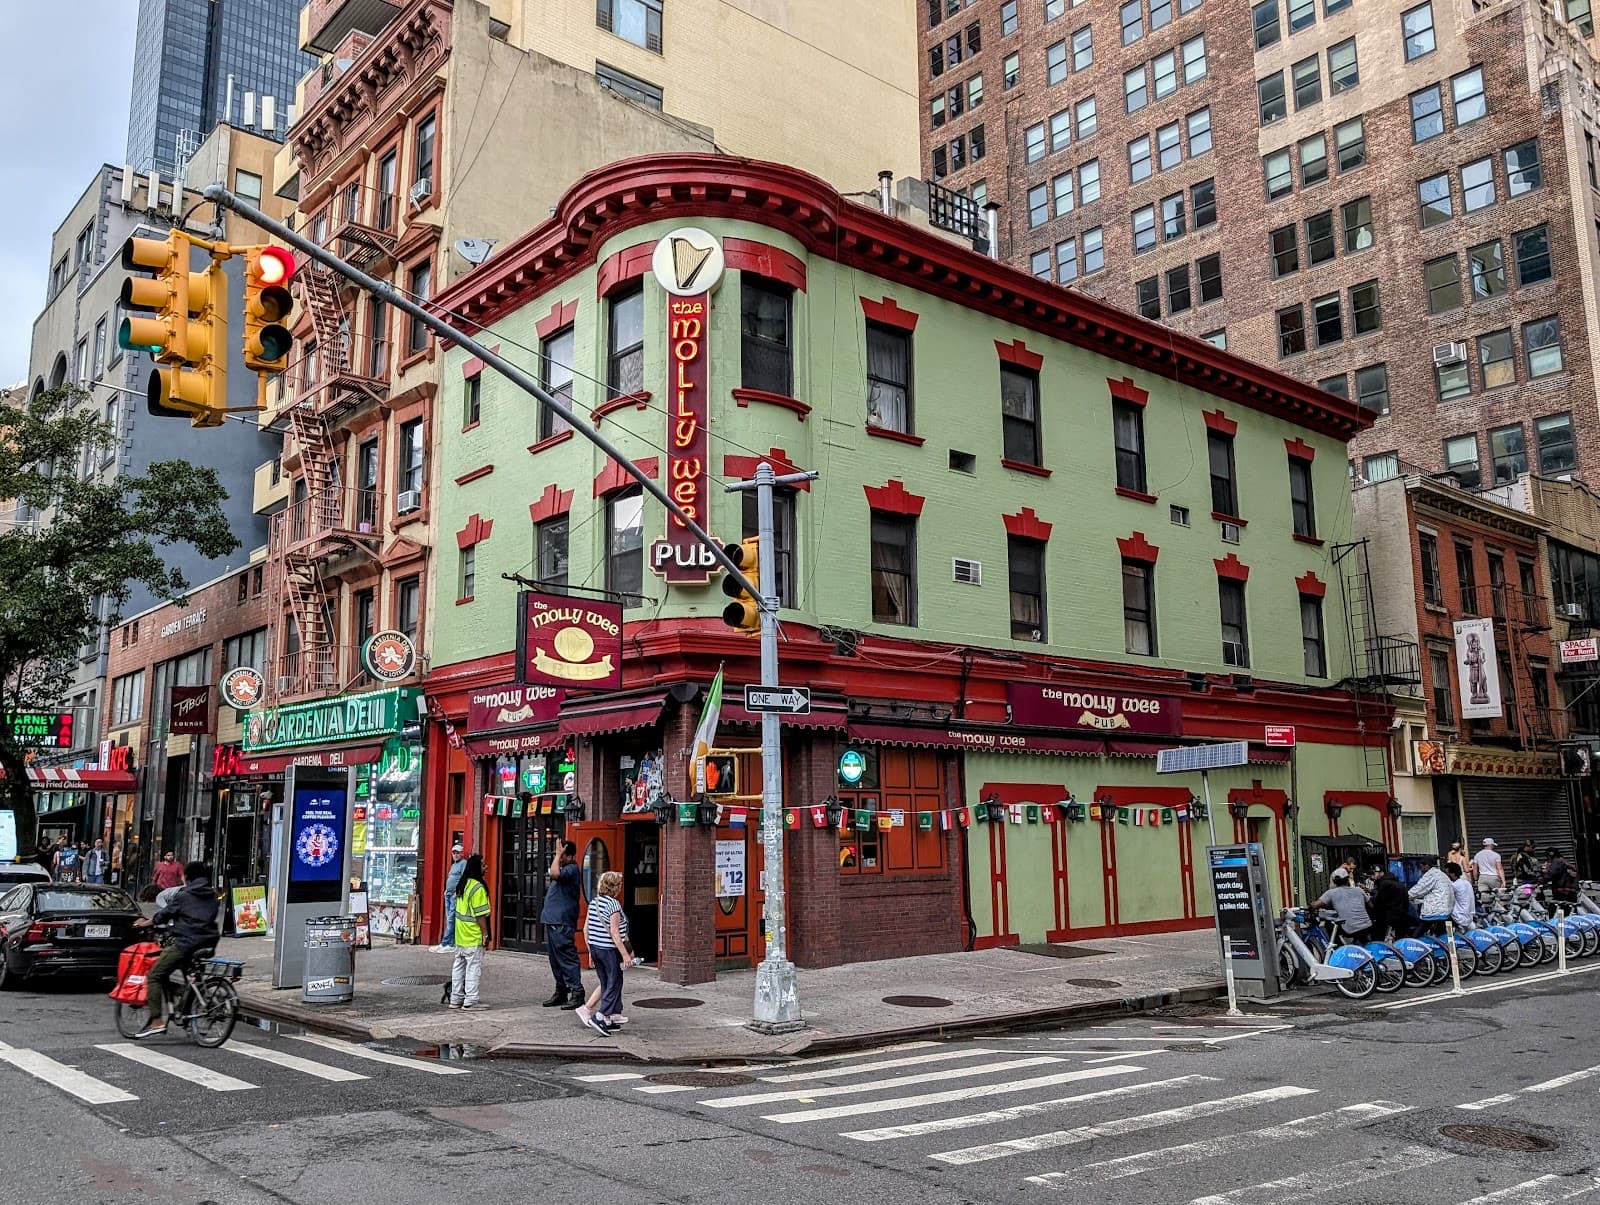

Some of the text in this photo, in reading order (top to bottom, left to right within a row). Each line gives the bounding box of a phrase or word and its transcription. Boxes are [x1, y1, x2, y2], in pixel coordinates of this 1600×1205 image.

[671, 301, 703, 315] the
[534, 601, 548, 610] the
[1564, 640, 1592, 649] SPACE
[1041, 688, 1062, 699] the
[751, 693, 801, 706] ONE WAY
[6, 714, 56, 724] LARNEY
[265, 698, 386, 744] GARDENIA DELI
[1094, 717, 1115, 728] PUB
[14, 725, 49, 735] STONE
[110, 746, 129, 770] KFC
[330, 752, 344, 765] DELI
[45, 781, 63, 789] Fried
[63, 781, 88, 789] Chicken
[402, 809, 420, 818] MTA
[1220, 871, 1237, 879] better
[1232, 882, 1243, 890] day
[1218, 891, 1249, 900] starts with
[1223, 902, 1237, 910] bike
